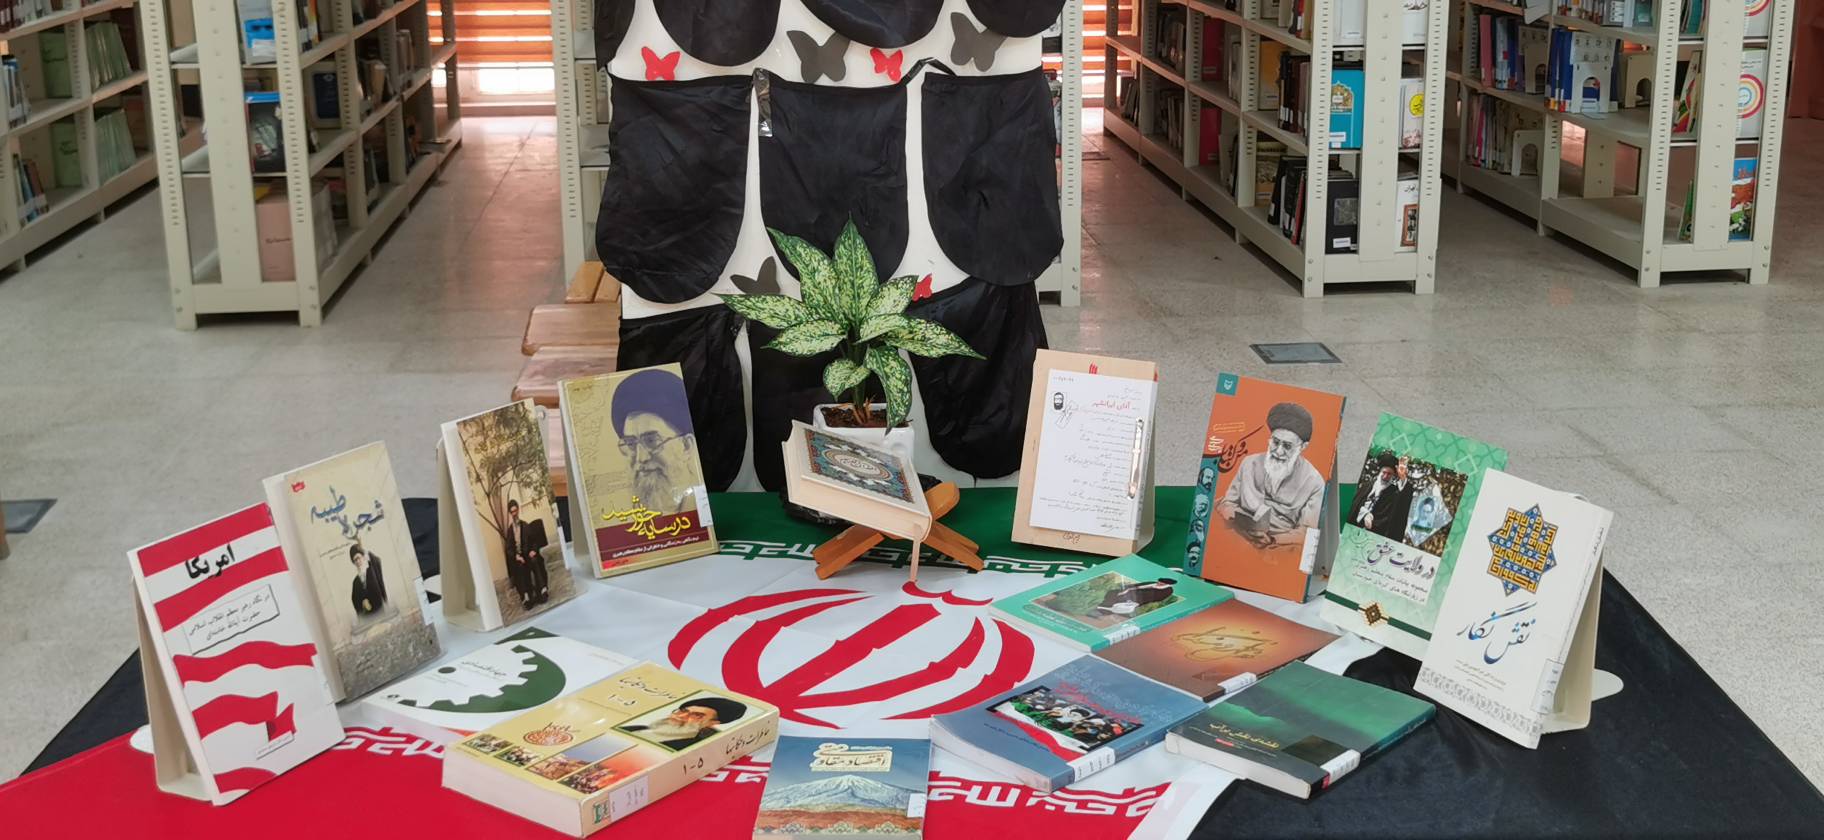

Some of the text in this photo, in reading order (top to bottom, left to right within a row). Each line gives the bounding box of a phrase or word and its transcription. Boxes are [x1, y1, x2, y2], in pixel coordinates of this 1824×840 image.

[185, 544, 236, 581] امریکا
[1366, 540, 1436, 580] در ولایت عشق
